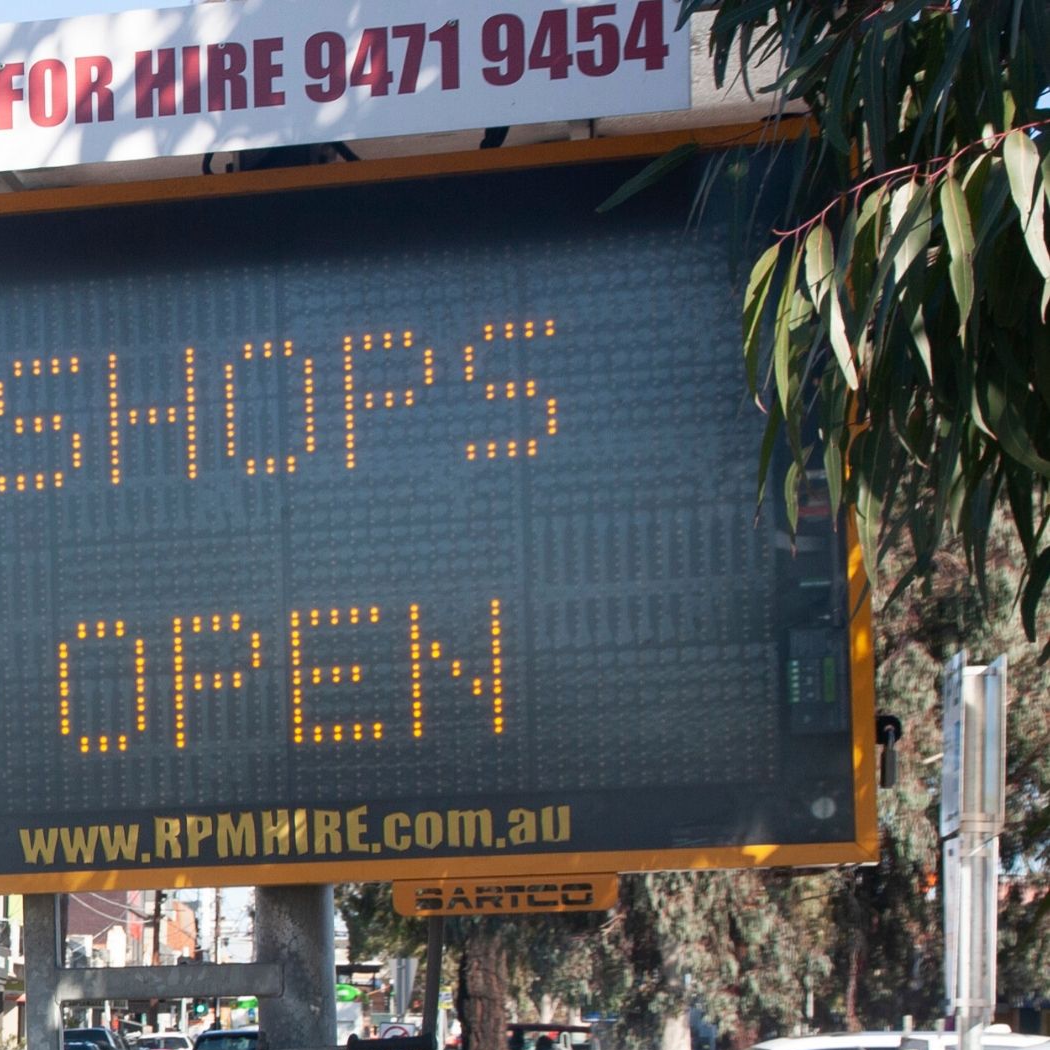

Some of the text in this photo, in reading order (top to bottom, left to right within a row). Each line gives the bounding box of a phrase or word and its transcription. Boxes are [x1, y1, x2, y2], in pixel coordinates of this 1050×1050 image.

[134, 36, 285, 119] HIRE
[304, 20, 461, 103] 9471
[482, 0, 669, 86] 9454
[58, 599, 504, 752] OPEN
